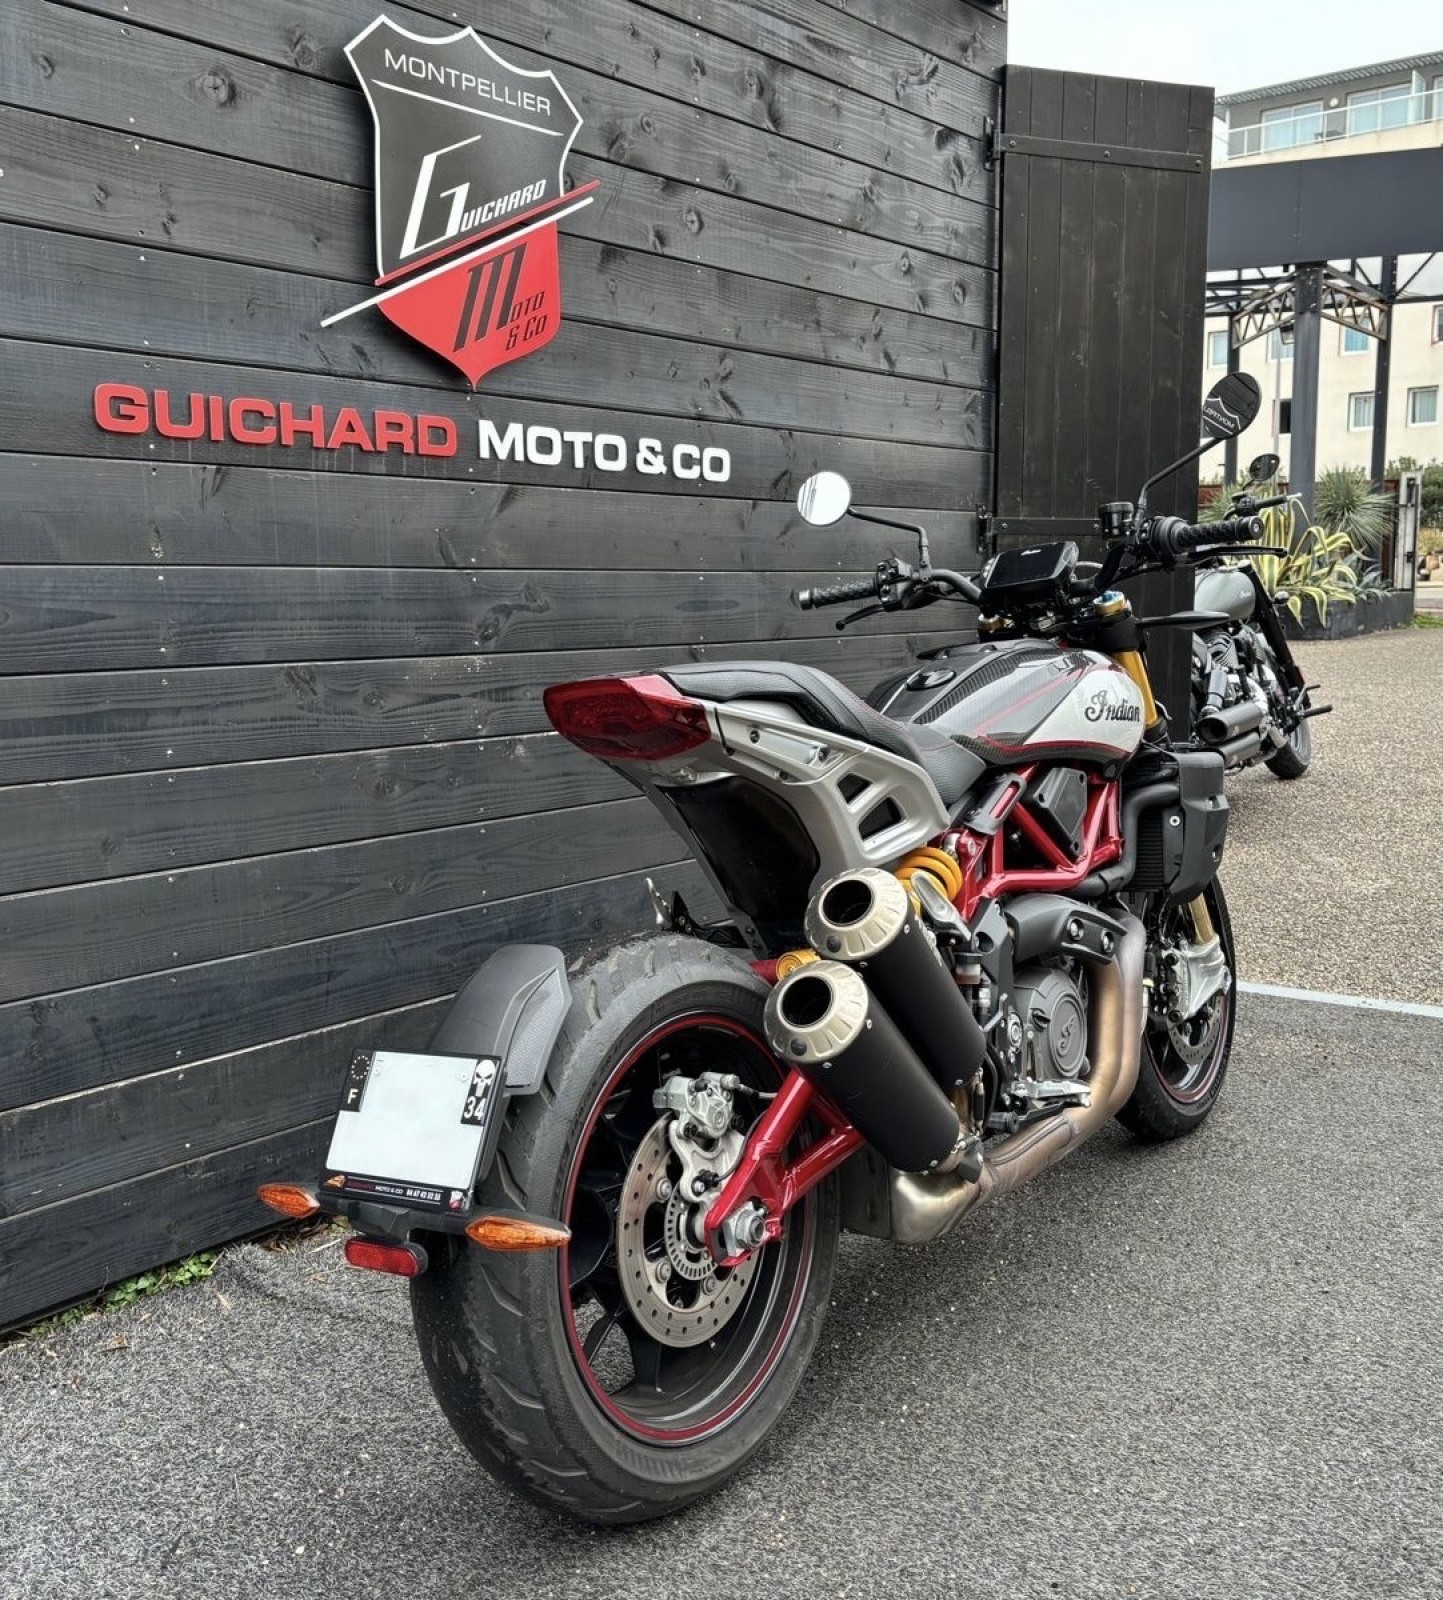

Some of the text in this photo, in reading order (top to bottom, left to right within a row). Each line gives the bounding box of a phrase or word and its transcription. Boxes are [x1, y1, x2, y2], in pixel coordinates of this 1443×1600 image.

[384, 48, 551, 116] MONTPELLIER
[399, 134, 548, 260] GUICHARD
[93, 383, 458, 458] GUICHARD
[478, 419, 628, 472] MOTO
[1084, 690, 1140, 722] Indian
[347, 1088, 359, 1105] F
[463, 1095, 486, 1121] 34
